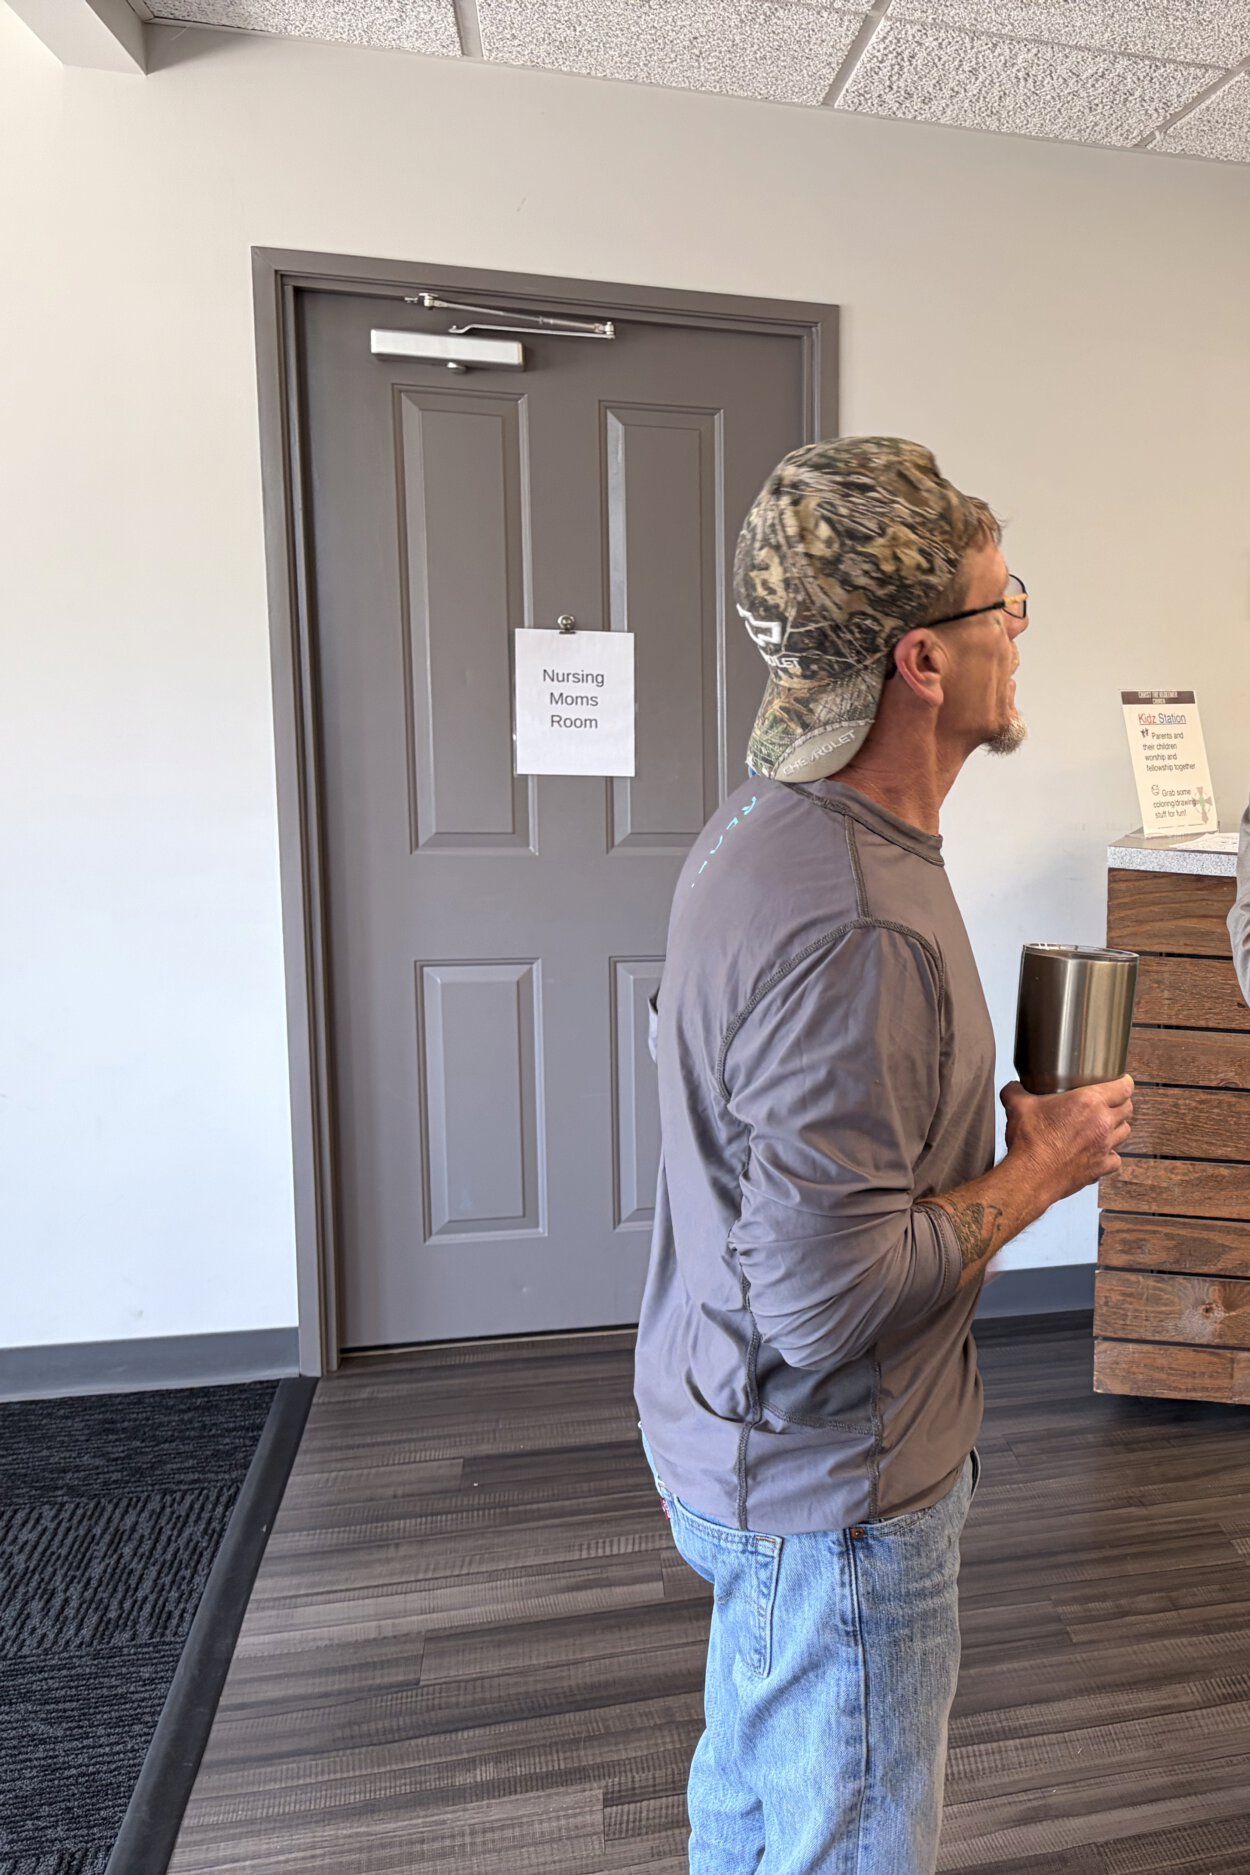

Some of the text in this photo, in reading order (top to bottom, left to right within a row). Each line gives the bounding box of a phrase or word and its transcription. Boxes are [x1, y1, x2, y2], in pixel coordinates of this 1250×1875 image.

[543, 669, 605, 688] Nursing
[550, 692, 599, 707] Moms
[551, 714, 598, 729] Room
[1138, 712, 1187, 725] Kidz Station
[1151, 732, 1184, 740] Parents and
[783, 729, 856, 776] CHEVROLET
[1156, 743, 1178, 751] children
[1161, 789, 1175, 797] Grab
